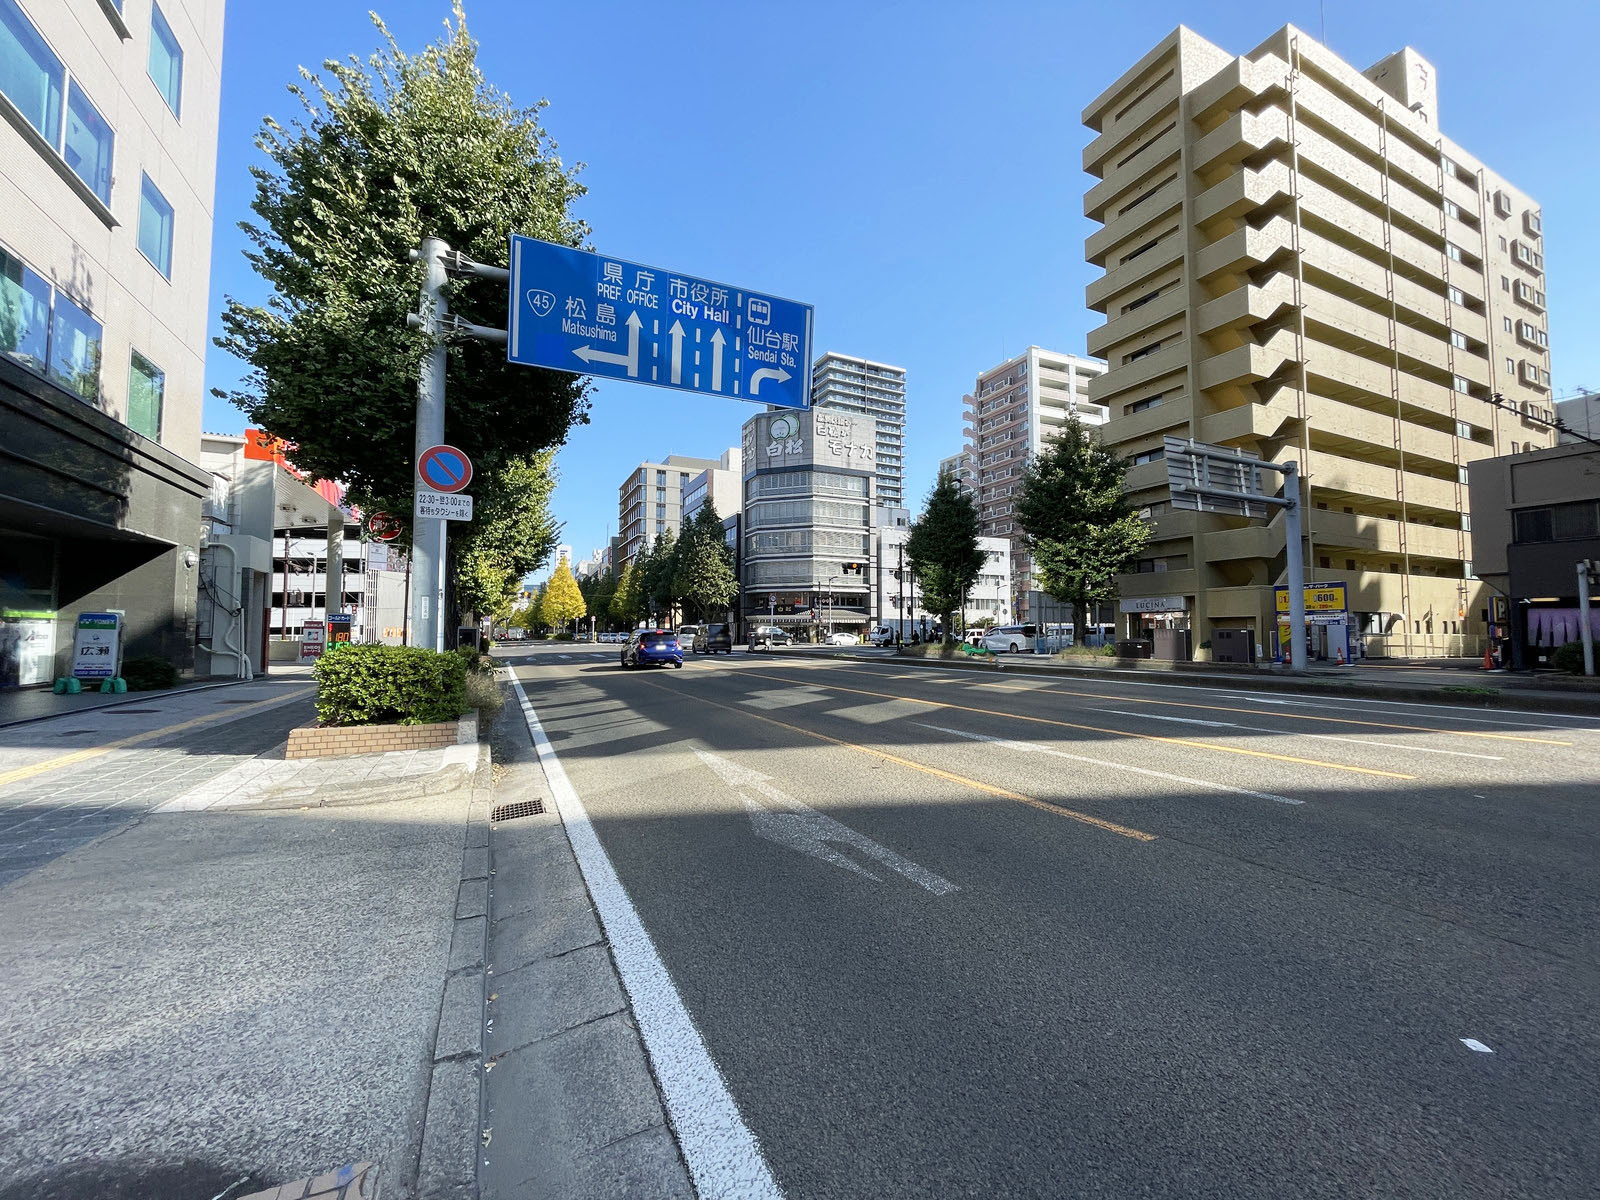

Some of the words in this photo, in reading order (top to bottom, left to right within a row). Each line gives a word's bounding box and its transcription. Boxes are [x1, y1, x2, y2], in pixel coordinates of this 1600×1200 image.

[603, 262, 655, 291] 県庁
[533, 293, 550, 309] 45
[597, 283, 623, 303] PREF.
[626, 288, 659, 310] OFFICE
[669, 278, 729, 309] 市役所
[565, 295, 616, 326] 松島
[671, 300, 698, 320] City
[703, 304, 730, 324] Hall
[561, 318, 618, 343] Matsushima
[746, 325, 800, 354] 仙台駅
[747, 347, 778, 364] Sendai
[780, 349, 798, 368] Sta.
[766, 439, 804, 458] 白松
[828, 439, 874, 461] モナカ
[335, 632, 349, 642] 180
